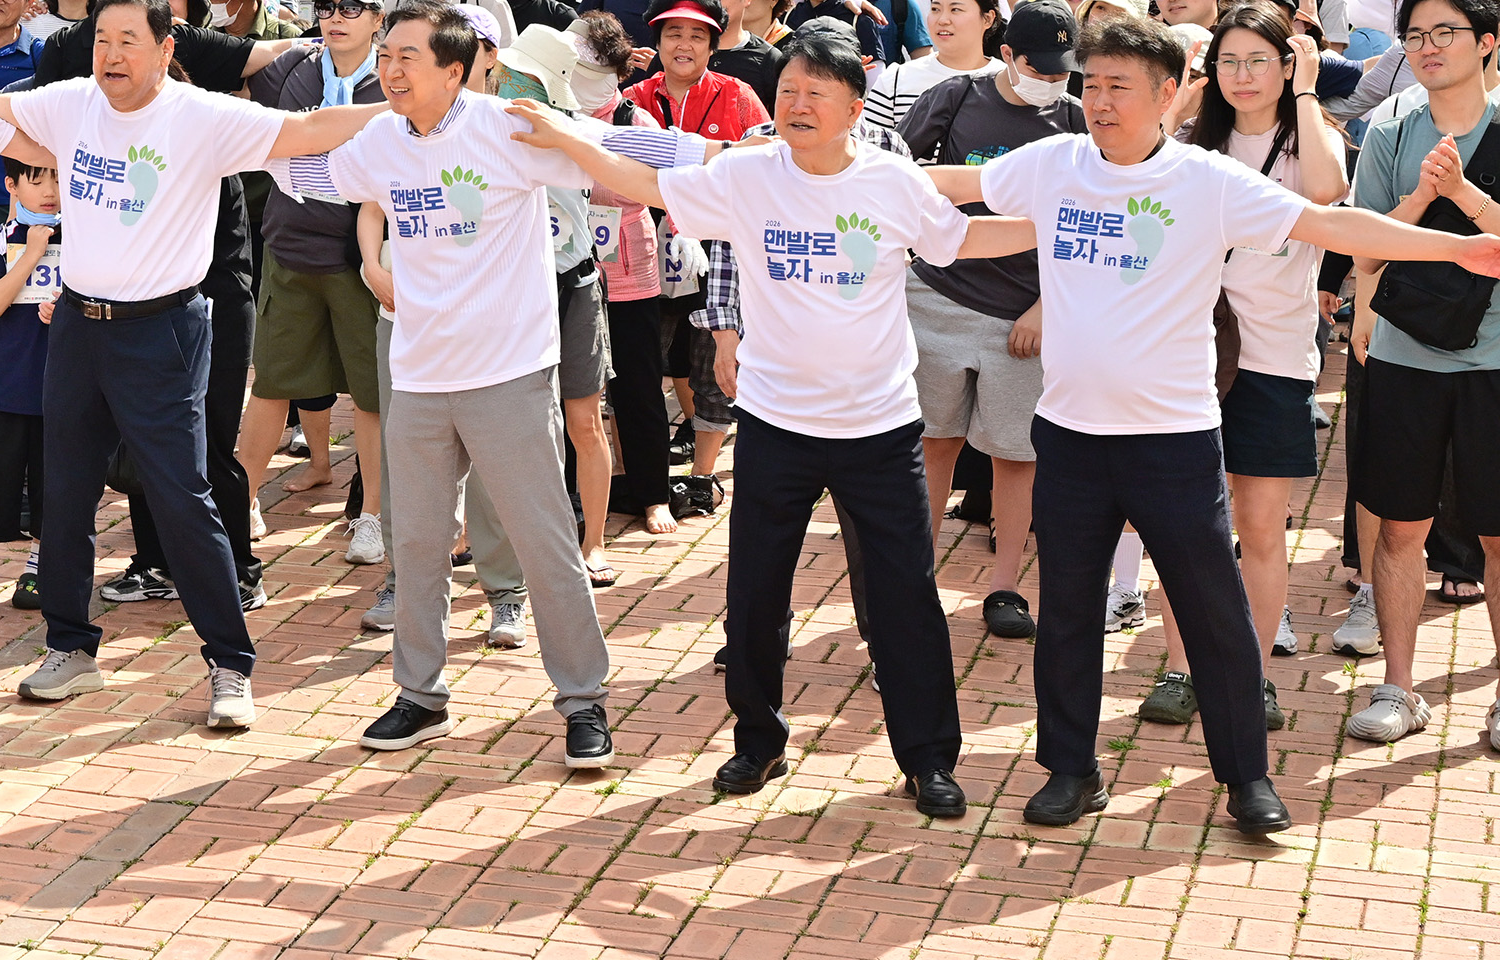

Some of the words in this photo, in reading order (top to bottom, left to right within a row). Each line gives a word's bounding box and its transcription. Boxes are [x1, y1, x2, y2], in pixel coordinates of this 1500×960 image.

[1058, 30, 1067, 42] NY
[72, 148, 126, 184] 맨발로
[70, 174, 104, 206] 놀자
[106, 198, 117, 210] in
[119, 198, 145, 213] 울산
[390, 186, 446, 212] 맨발로
[1061, 198, 1076, 206] 2026
[396, 214, 428, 238] 놀자
[434, 226, 448, 238] in
[450, 220, 476, 236] 울산
[595, 226, 610, 246] 9
[766, 220, 781, 228] 2026
[1056, 207, 1124, 238] 맨발로
[764, 229, 837, 257] 맨발로
[1054, 234, 1098, 264] 놀자
[1104, 254, 1116, 266] in
[1120, 254, 1148, 270] 울산
[767, 256, 813, 282] 놀자
[820, 272, 832, 284] in
[836, 272, 866, 285] 울산
